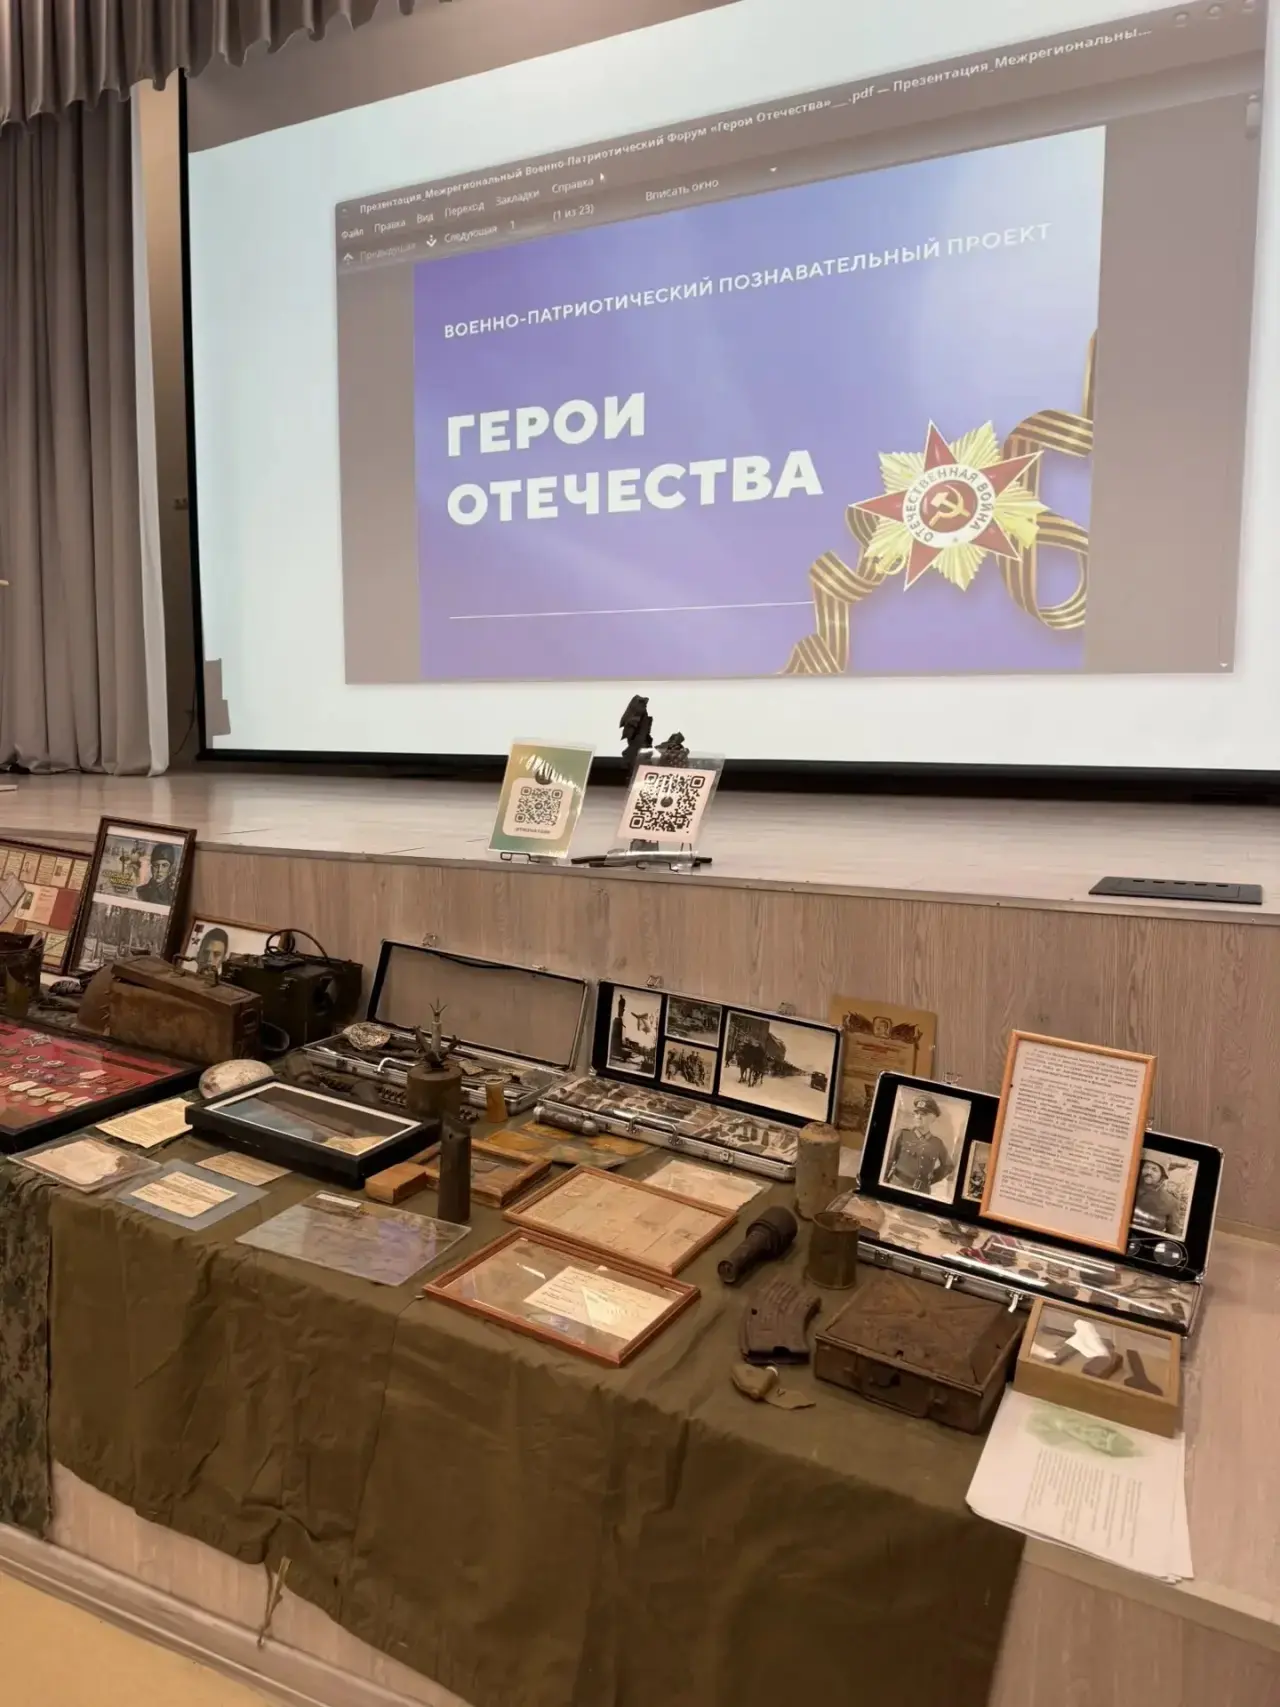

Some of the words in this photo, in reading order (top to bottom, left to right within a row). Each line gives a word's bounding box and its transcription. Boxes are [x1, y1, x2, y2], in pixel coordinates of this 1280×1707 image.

[667, 127, 708, 144] Форум
[341, 227, 365, 240] Файл
[374, 218, 407, 234] Правка
[416, 212, 435, 224] Вид
[444, 201, 486, 219] Переход
[496, 189, 541, 207] Закладки
[551, 176, 595, 195] Справка
[443, 225, 498, 244] Следующая
[564, 207, 577, 217] из
[579, 203, 595, 216] 23)
[645, 186, 690, 202] Вписать
[691, 178, 720, 193] окно
[443, 276, 714, 339] ВОЕННО-ПАТРИОТИЧЕСКИЙ
[719, 239, 940, 295] ПОЗНАВАТЕЛЬНЫЙ
[947, 222, 1053, 256] ПРОЕКТ
[447, 392, 646, 457] ГЕРОИ
[447, 450, 824, 526] ОТЕЧЕСТВА
[906, 467, 979, 543] ОТЕЧЕСТВЕННАЯ
